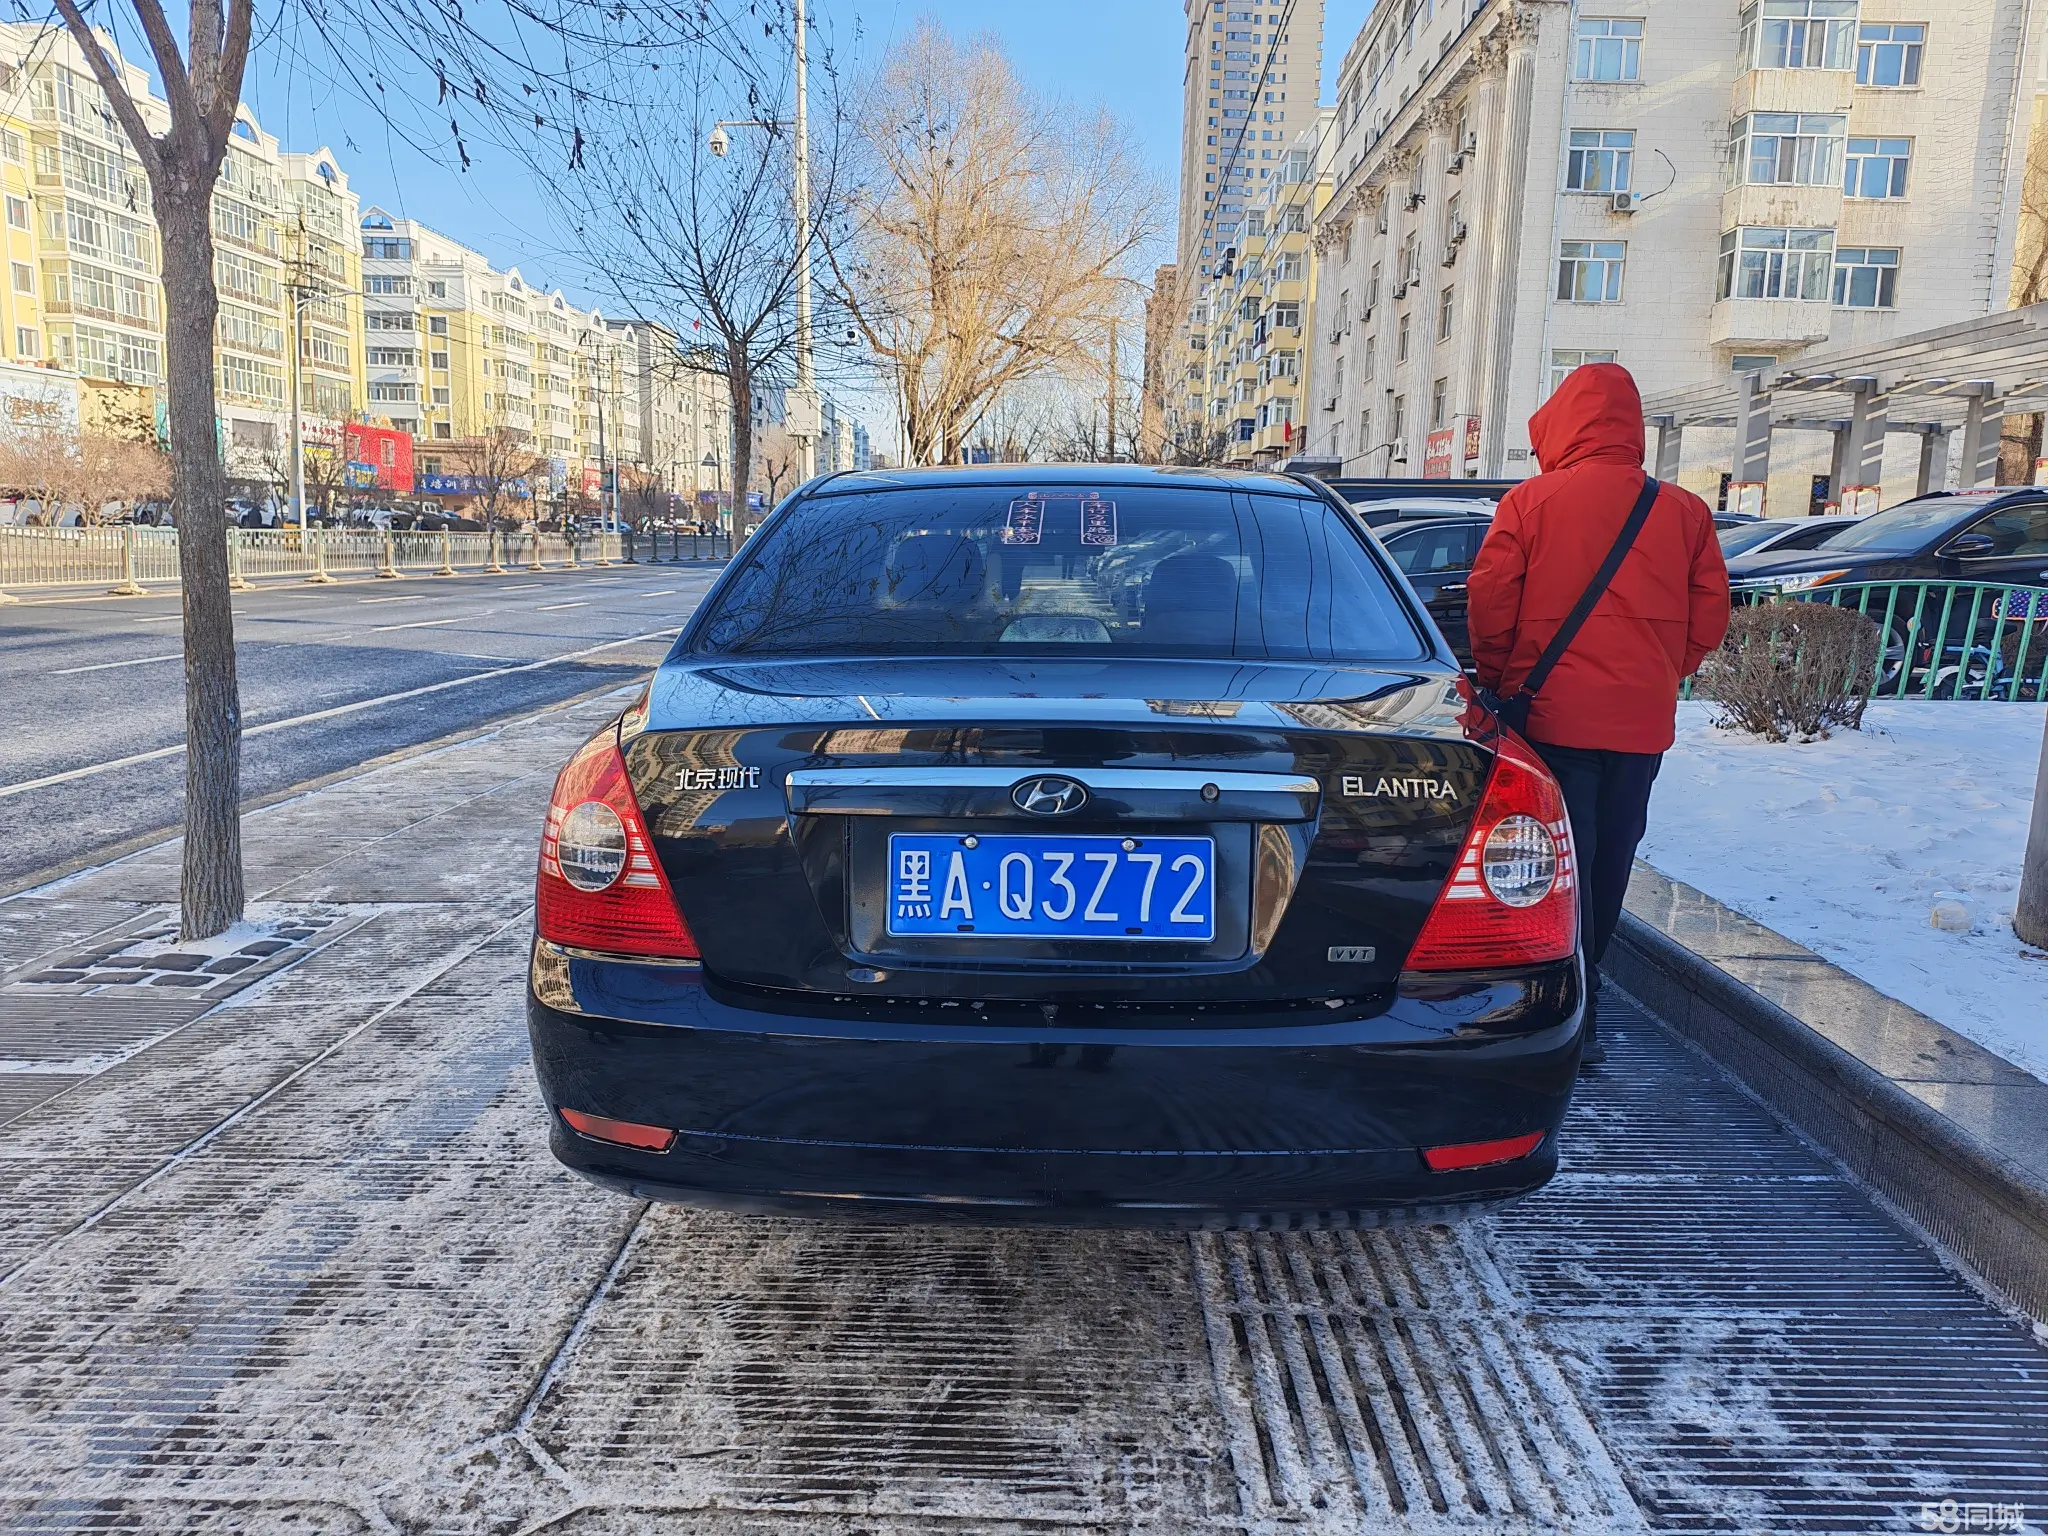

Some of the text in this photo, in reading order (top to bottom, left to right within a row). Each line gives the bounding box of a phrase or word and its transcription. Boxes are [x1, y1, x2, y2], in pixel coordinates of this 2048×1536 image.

[674, 766, 760, 790] 北京现代
[1342, 776, 1458, 800] ELANTRA
[898, 850, 1206, 923] 黑A·Q3Z72
[1336, 949, 1370, 960] VVT
